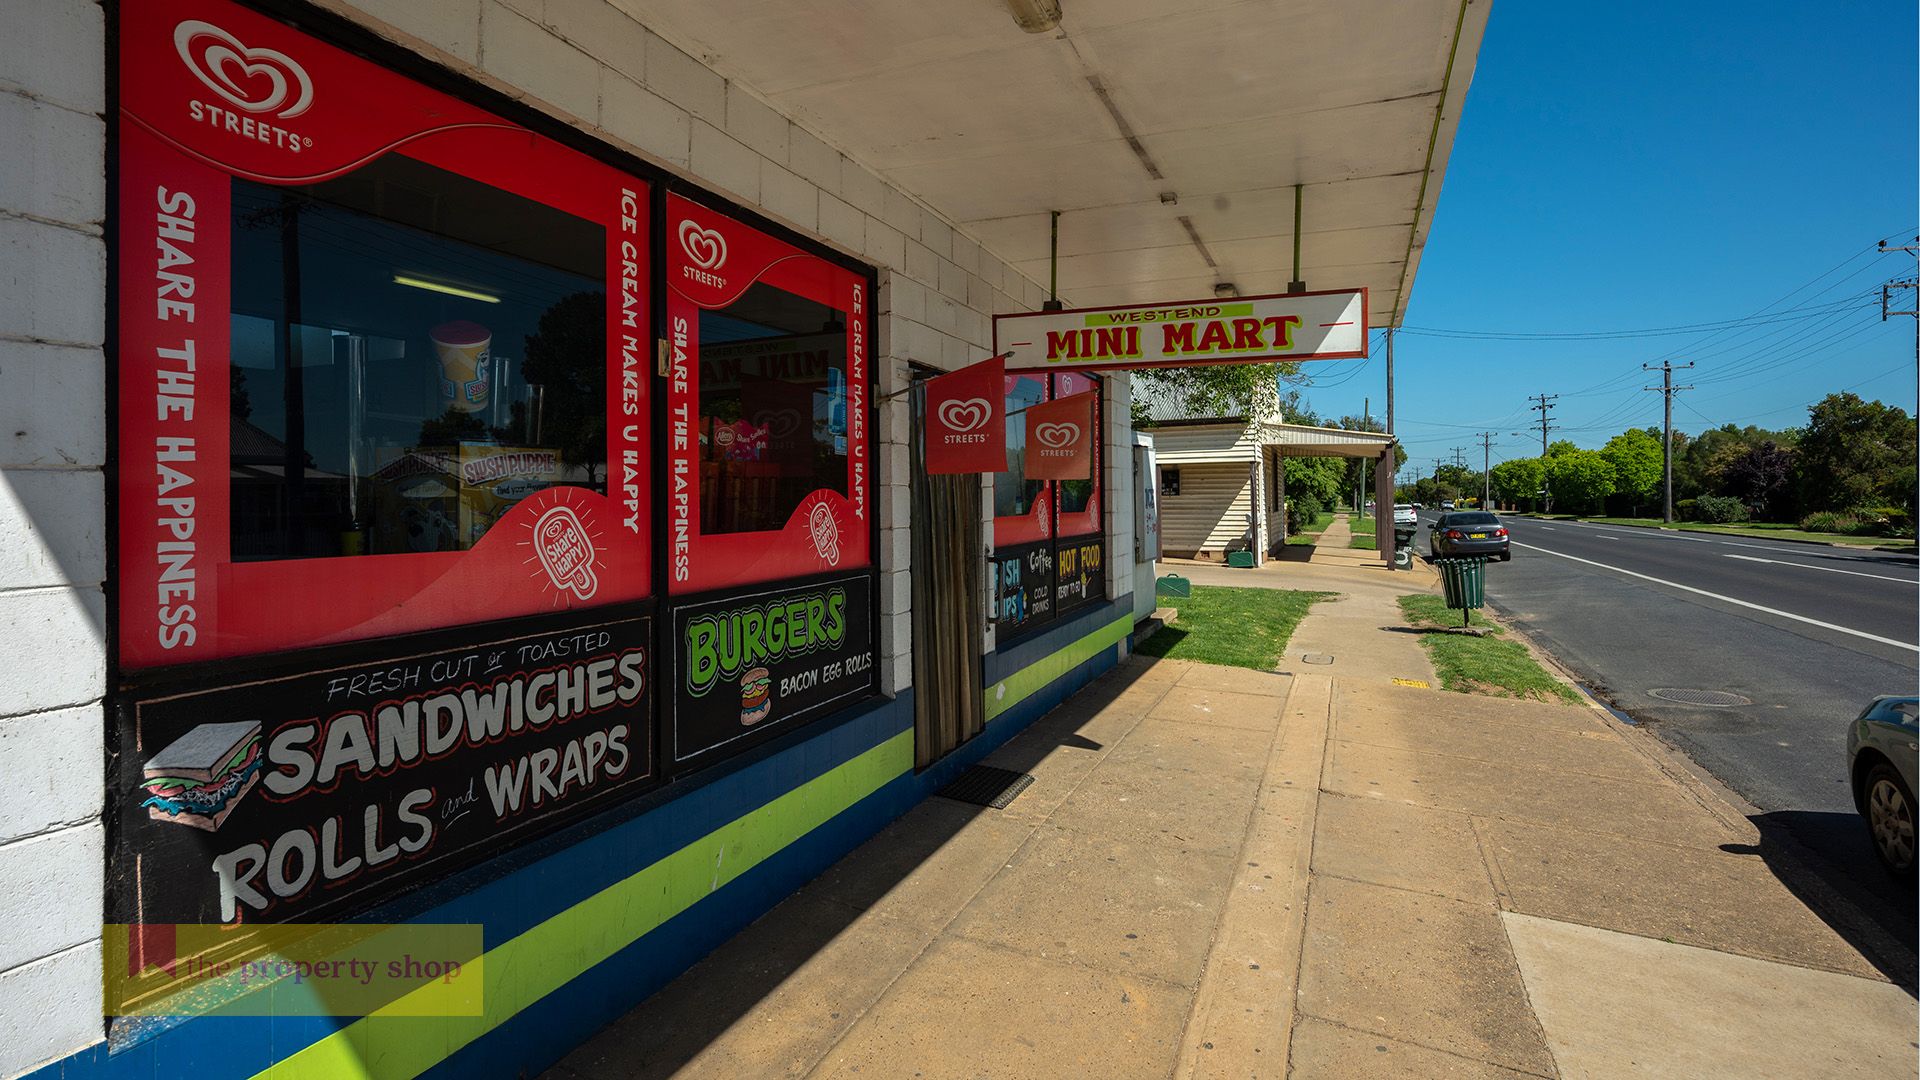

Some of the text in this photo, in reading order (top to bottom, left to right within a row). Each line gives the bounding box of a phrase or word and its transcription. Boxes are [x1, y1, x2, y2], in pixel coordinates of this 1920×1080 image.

[1046, 315, 1301, 360] MINI MART
[1109, 306, 1221, 323] WESTEND
[621, 187, 639, 534] ICE CREAM MAKES U HAPPY
[156, 185, 197, 650] SHARE THE HAPPINESS
[853, 283, 864, 521] ICE CREAM MAKES U HAPPY
[673, 316, 689, 582] SHARE THE HAPPINESS
[944, 434, 986, 444] STREETS
[463, 452, 555, 484] SLUSH PUPPIE
[1029, 548, 1053, 575] Coffee
[1059, 544, 1101, 577] HOT FOOD
[1031, 598, 1050, 616] DRINKS
[1033, 584, 1049, 600] COLD
[689, 592, 844, 685] BURGERS
[327, 665, 421, 702] FRESH
[430, 654, 479, 683] CUT
[516, 631, 611, 665] TOASTED
[780, 652, 872, 698] BACON EGG ROLLS
[263, 651, 643, 795] SANDWICHES
[211, 724, 629, 924] ROLLS and WRAPS
